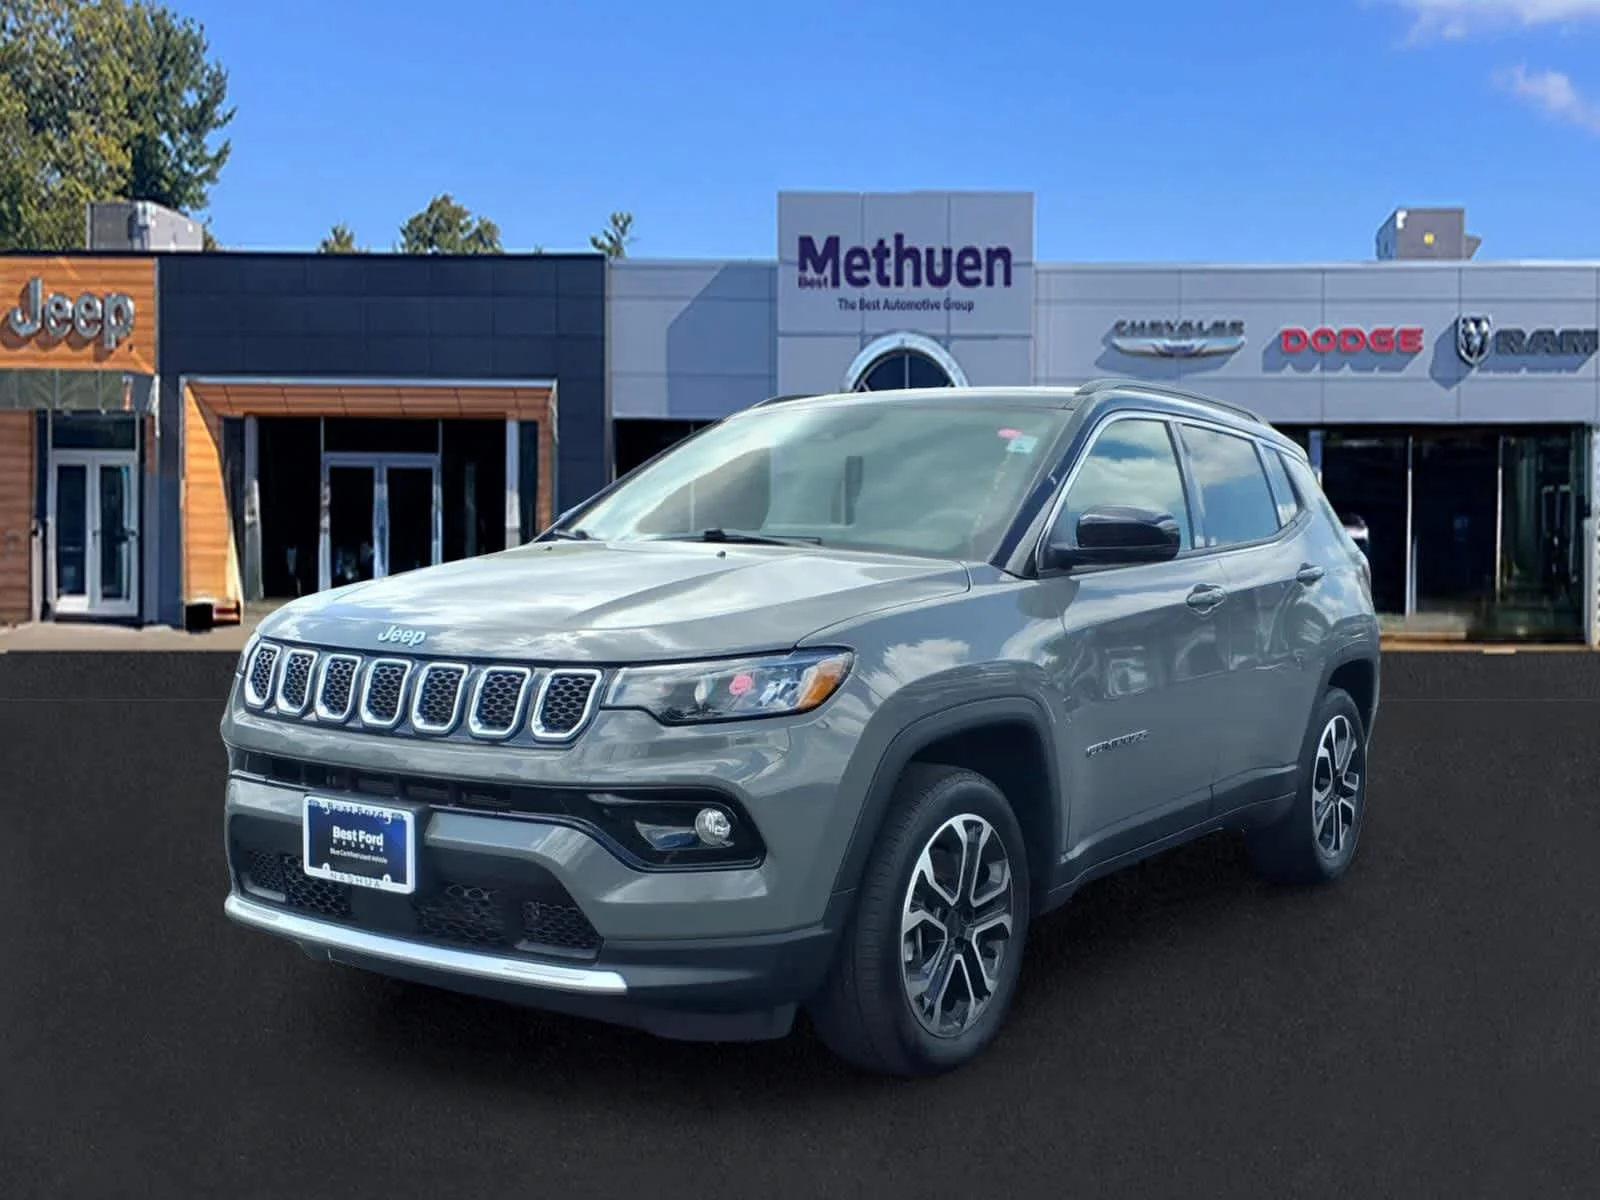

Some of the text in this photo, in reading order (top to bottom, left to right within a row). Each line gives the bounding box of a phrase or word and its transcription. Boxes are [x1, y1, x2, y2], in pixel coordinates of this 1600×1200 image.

[798, 233, 1012, 288] Methuen
[8, 275, 135, 350] Jeep
[838, 298, 974, 314] The Best Automotive Group
[1281, 327, 1424, 353] DODGE
[1496, 328, 1598, 355] RAM
[377, 624, 426, 647] Jeep
[333, 825, 357, 842] Best
[359, 831, 384, 847] Ford
